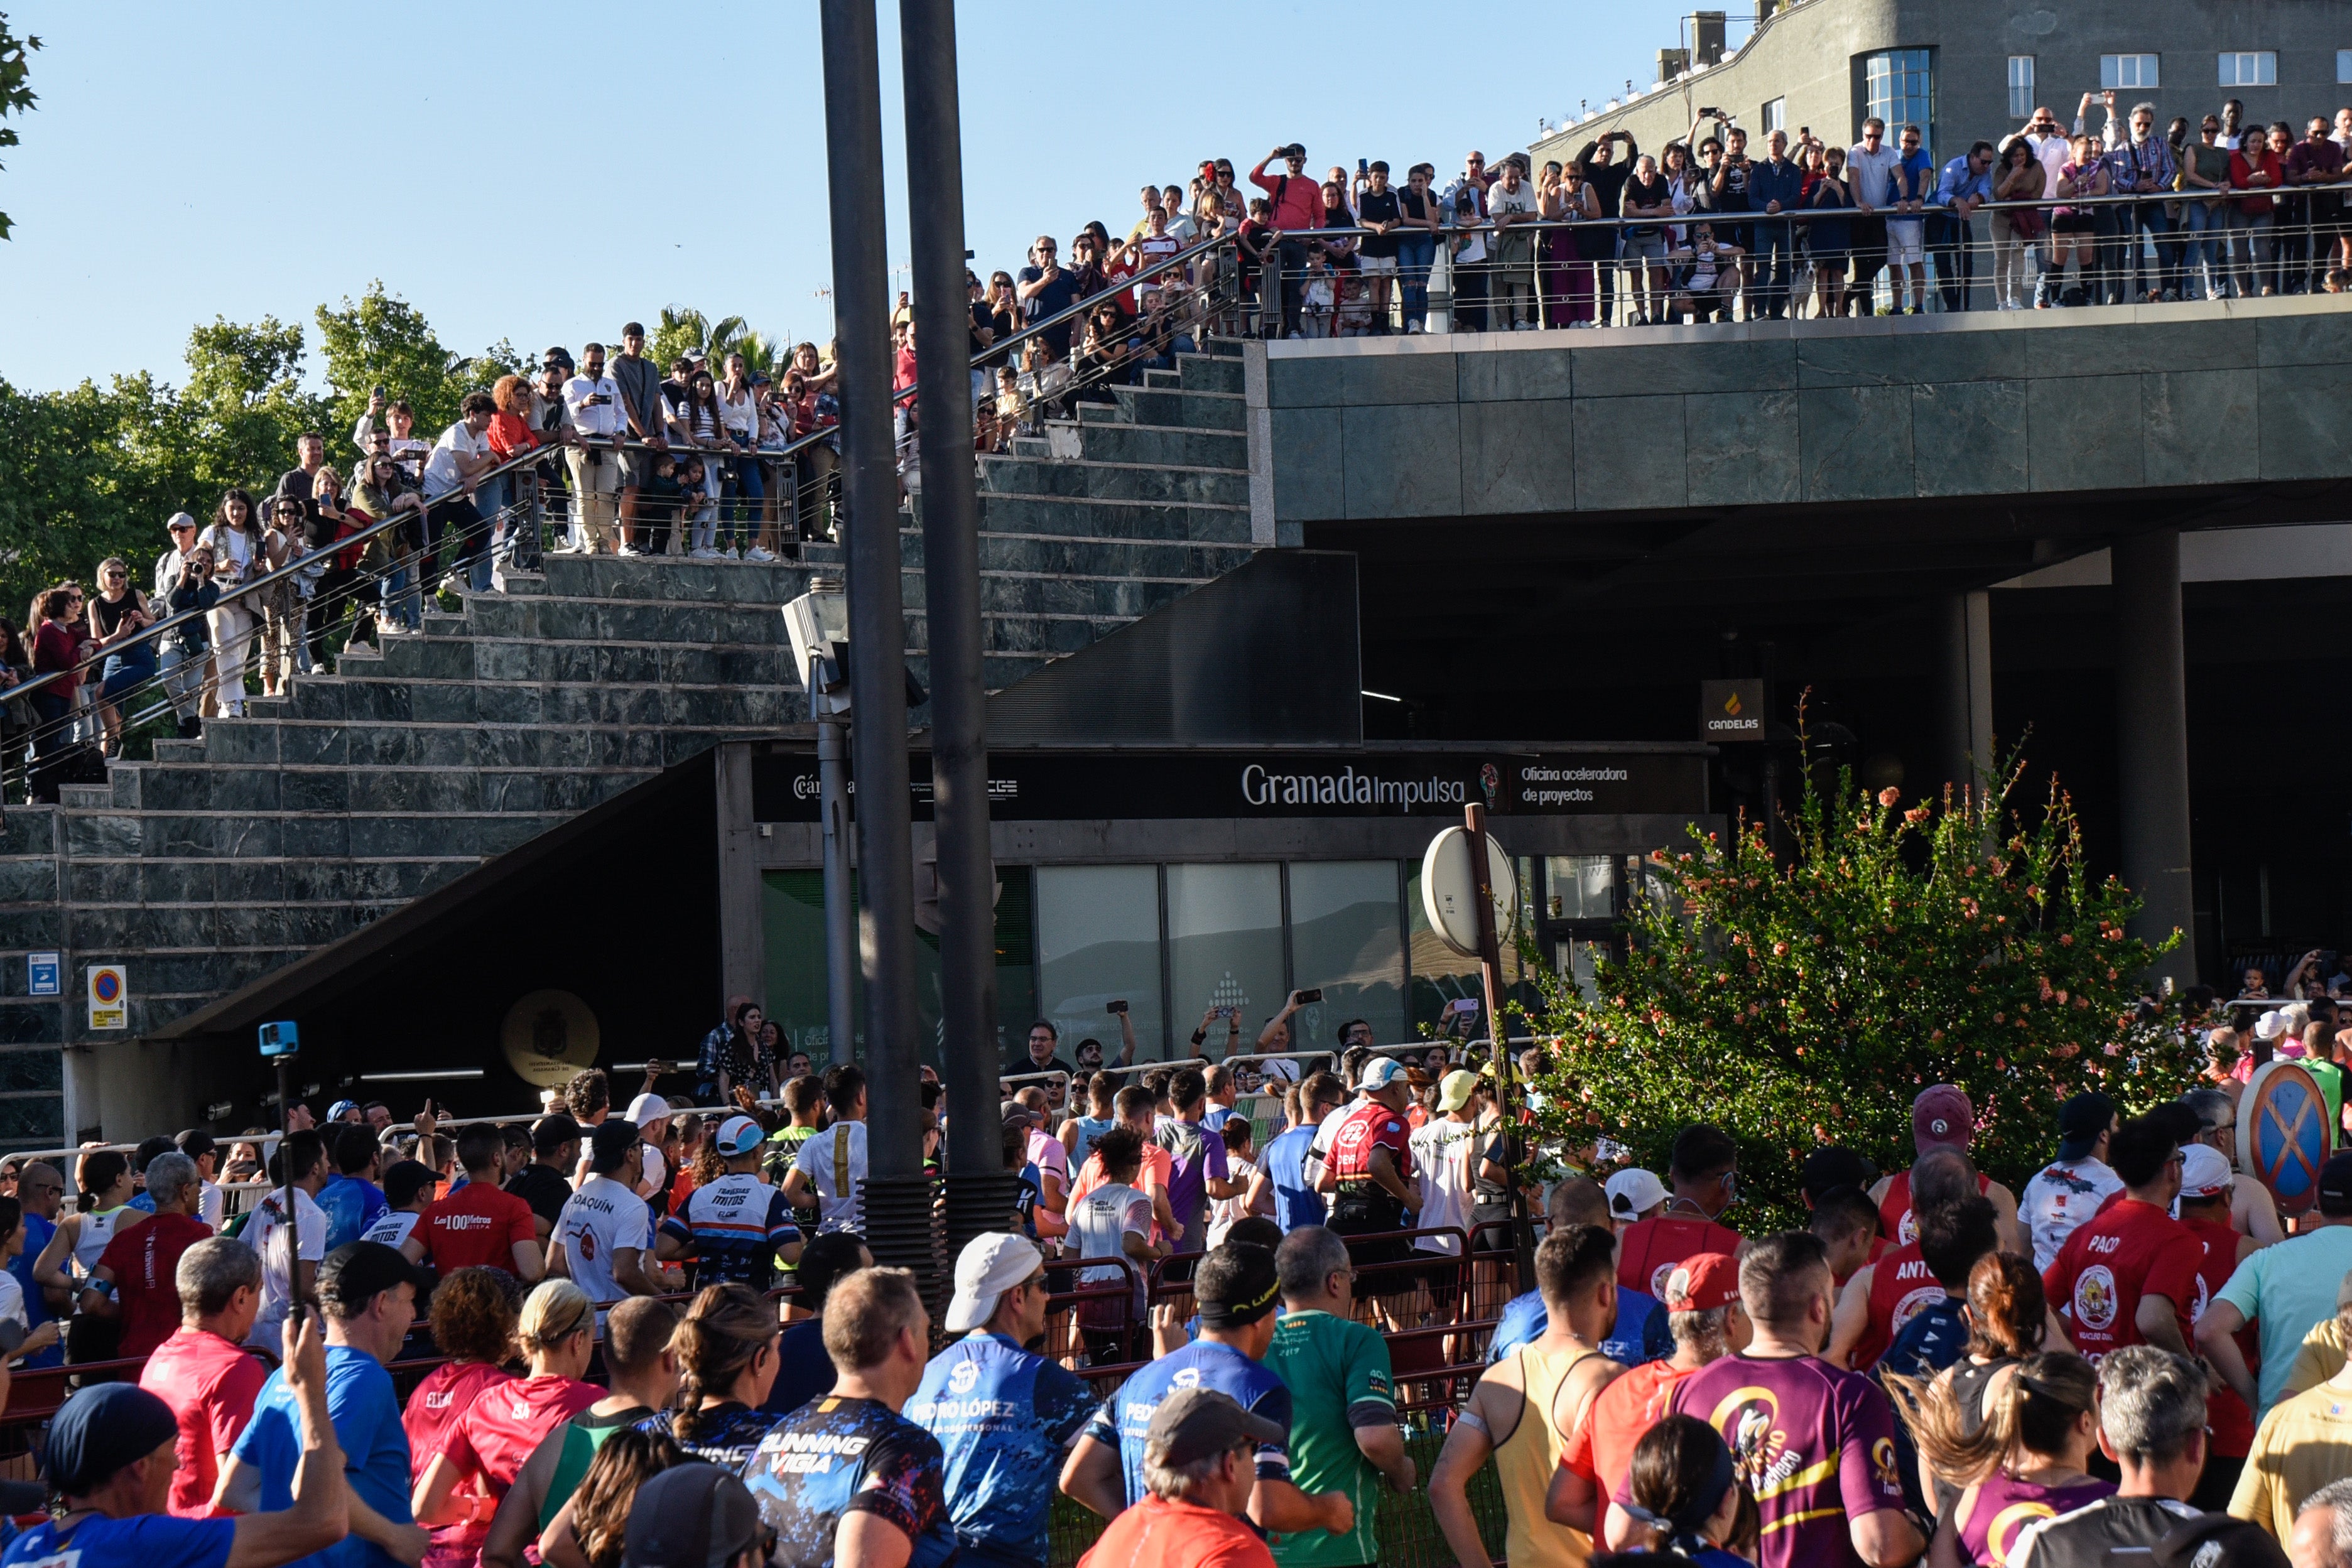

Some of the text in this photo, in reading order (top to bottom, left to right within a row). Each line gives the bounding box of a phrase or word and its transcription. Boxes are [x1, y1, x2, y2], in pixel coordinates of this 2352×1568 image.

[1708, 719, 1758, 730] CANDELAS
[1521, 767, 1627, 781] Oficina aceleradora
[1522, 787, 1599, 806] de proyectos
[711, 1195, 747, 1206] MITOS
[2088, 1235, 2120, 1253] PACO
[912, 1398, 1014, 1422] PEDRO LÓPEZ
[1125, 1402, 1158, 1422] PED
[757, 1432, 871, 1455] RUNNING
[771, 1452, 832, 1474] VIGIA
[1750, 1449, 1802, 1498] Pacheco
